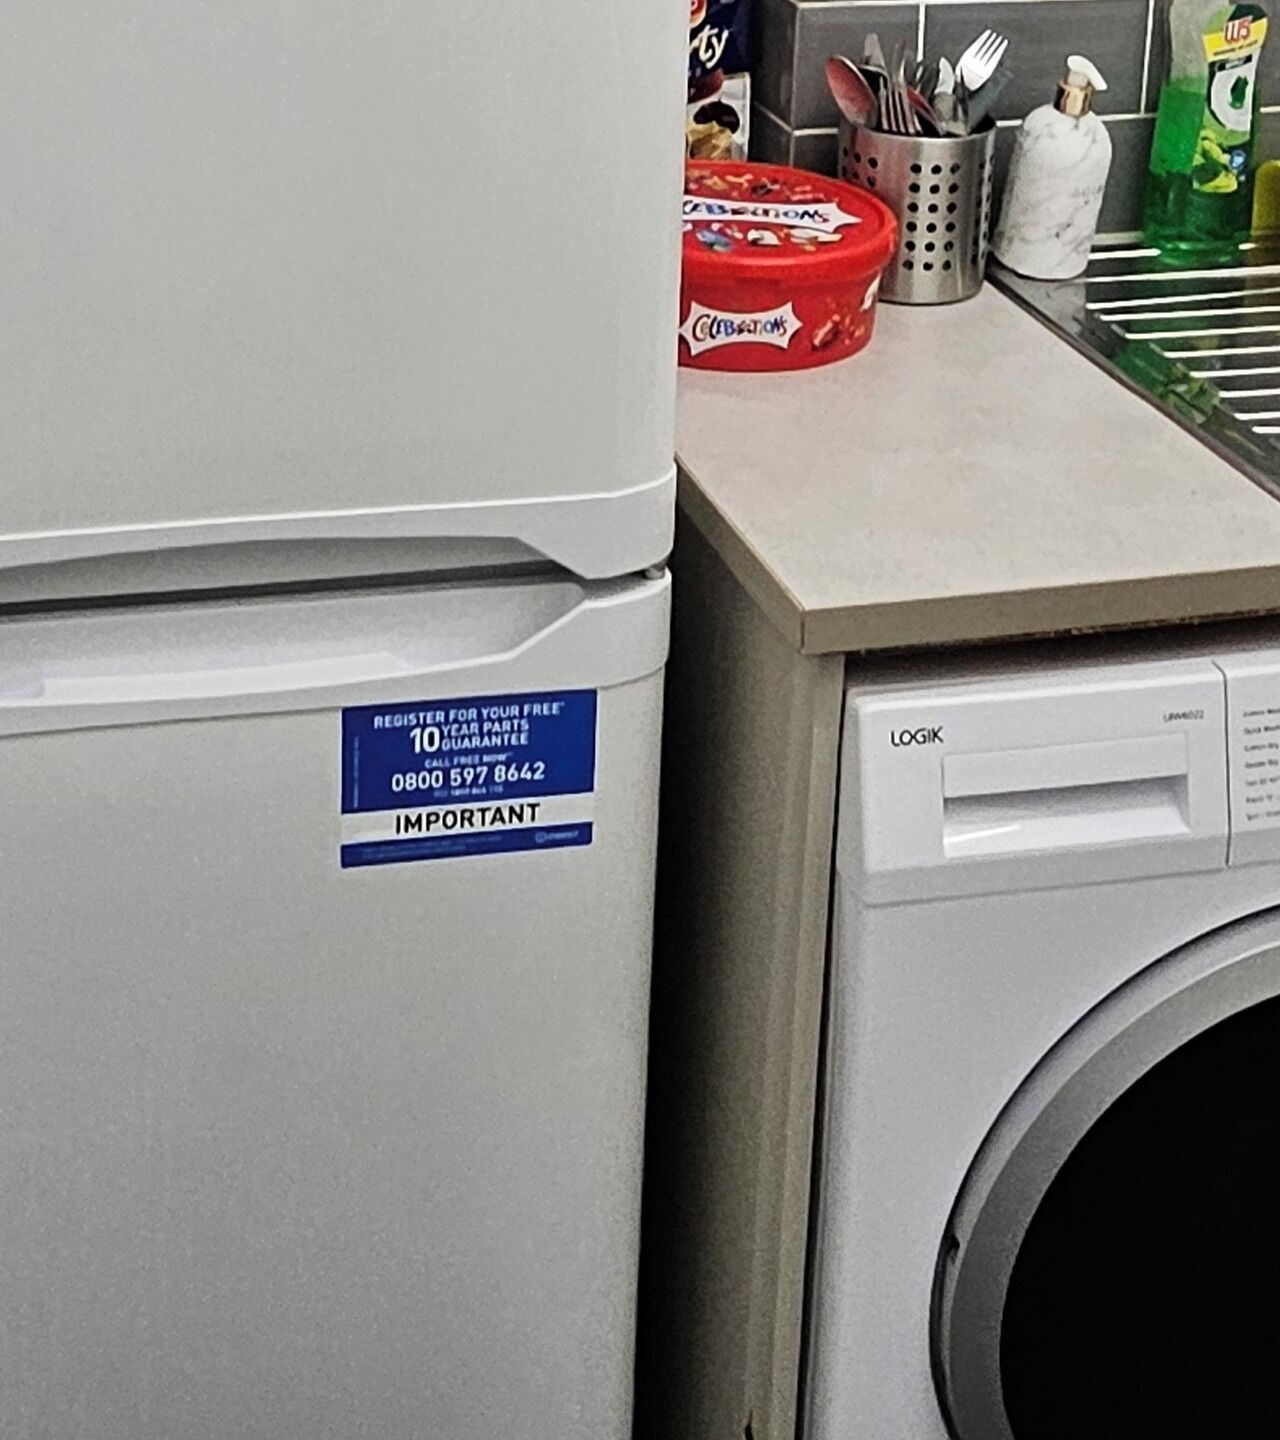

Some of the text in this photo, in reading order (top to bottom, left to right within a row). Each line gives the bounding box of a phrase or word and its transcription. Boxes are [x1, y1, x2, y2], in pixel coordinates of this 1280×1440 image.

[373, 711, 445, 729] REGISTER
[449, 708, 478, 723] FOR
[481, 705, 520, 720] YOUR
[410, 718, 530, 754] 10 YEAR PARTS
[441, 732, 529, 751] GUARANTEE
[890, 726, 944, 747] LOGIK
[391, 770, 444, 792] 0800
[449, 766, 488, 787] 597
[494, 761, 546, 783] 8642
[395, 803, 541, 834] IMPORTANT
